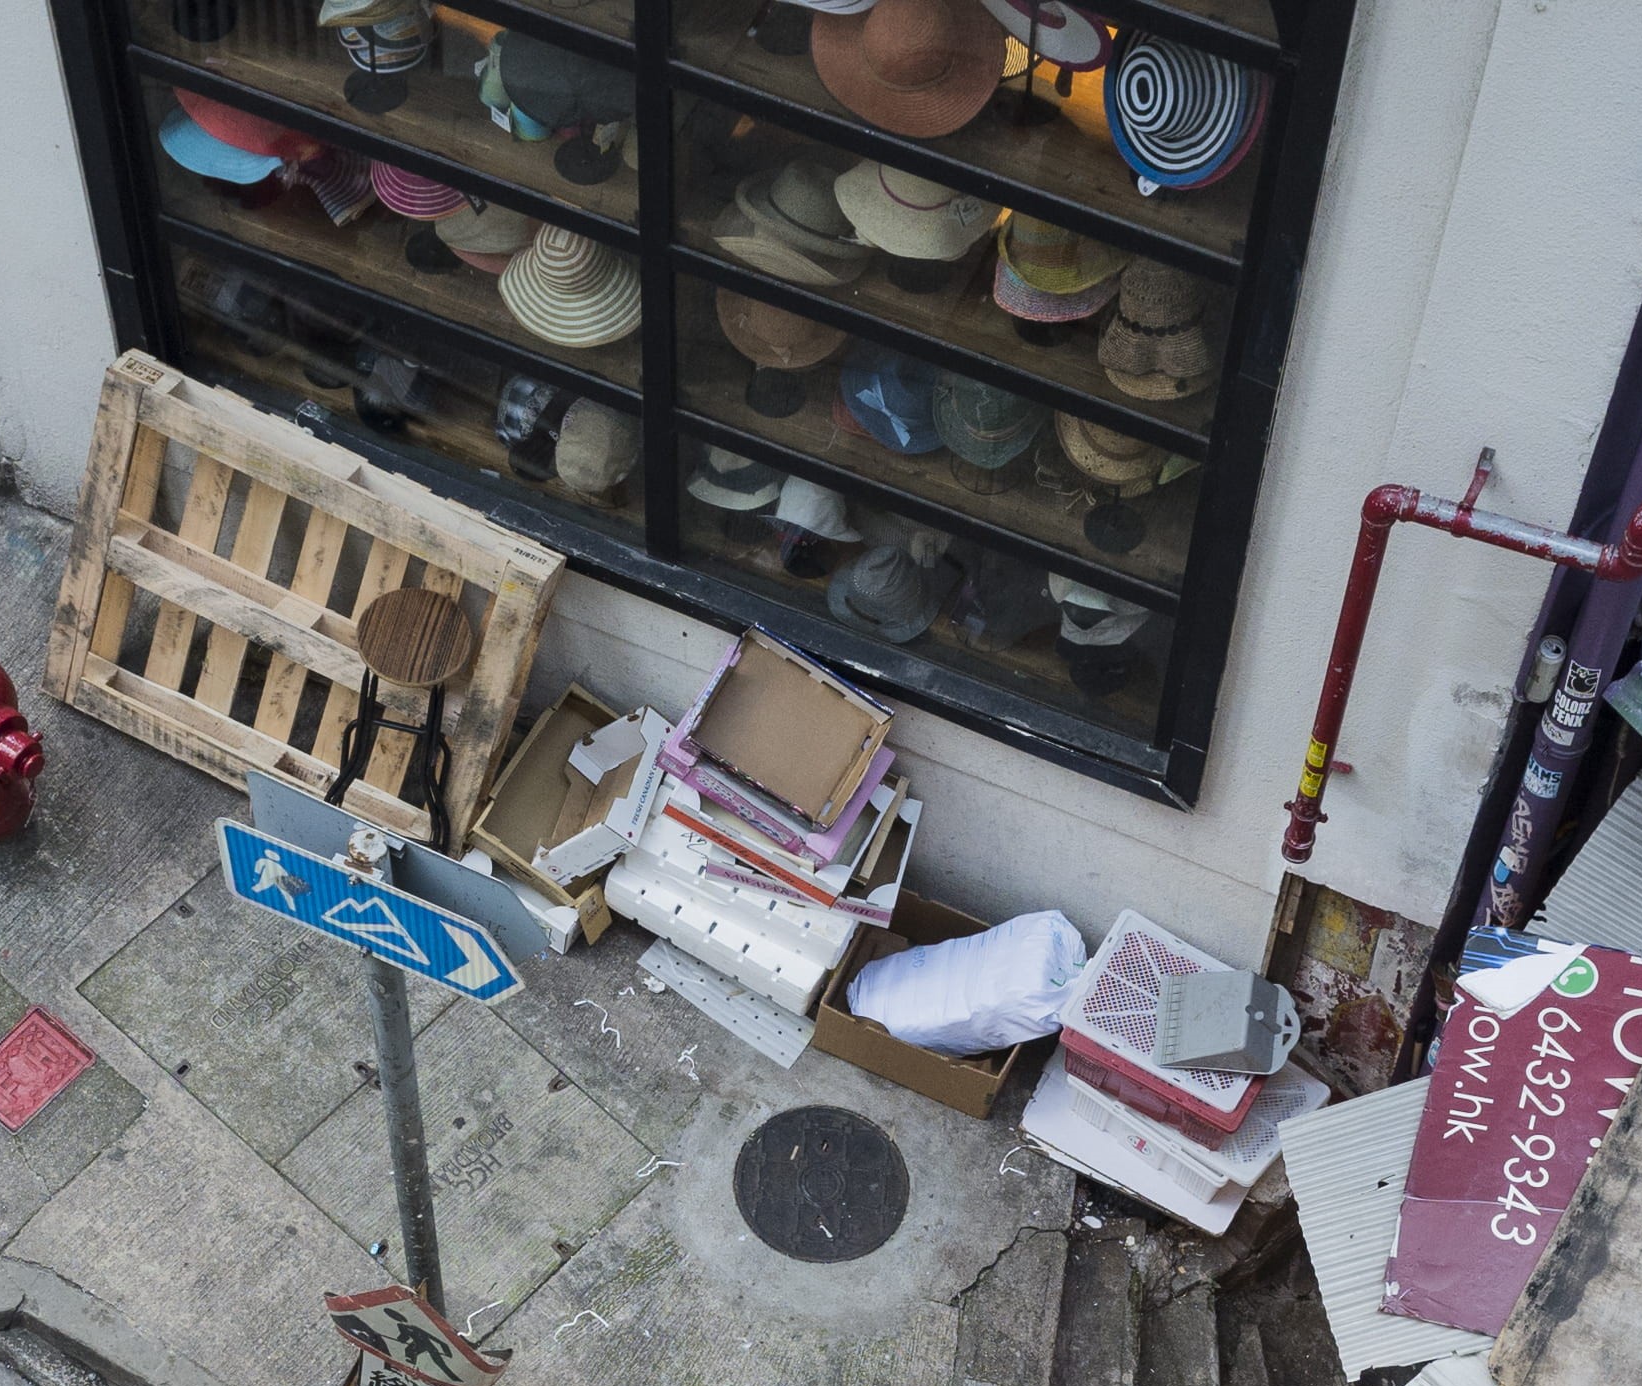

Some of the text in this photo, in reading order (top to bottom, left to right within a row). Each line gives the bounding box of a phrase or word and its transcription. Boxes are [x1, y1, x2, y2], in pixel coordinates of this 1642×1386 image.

[1552, 705, 1585, 728] FENX
[1554, 690, 1594, 716] COLORZ
[211, 942, 315, 1028] BROADBAND
[256, 977, 304, 1022] HGC
[1490, 1006, 1582, 1246] 6432-9343
